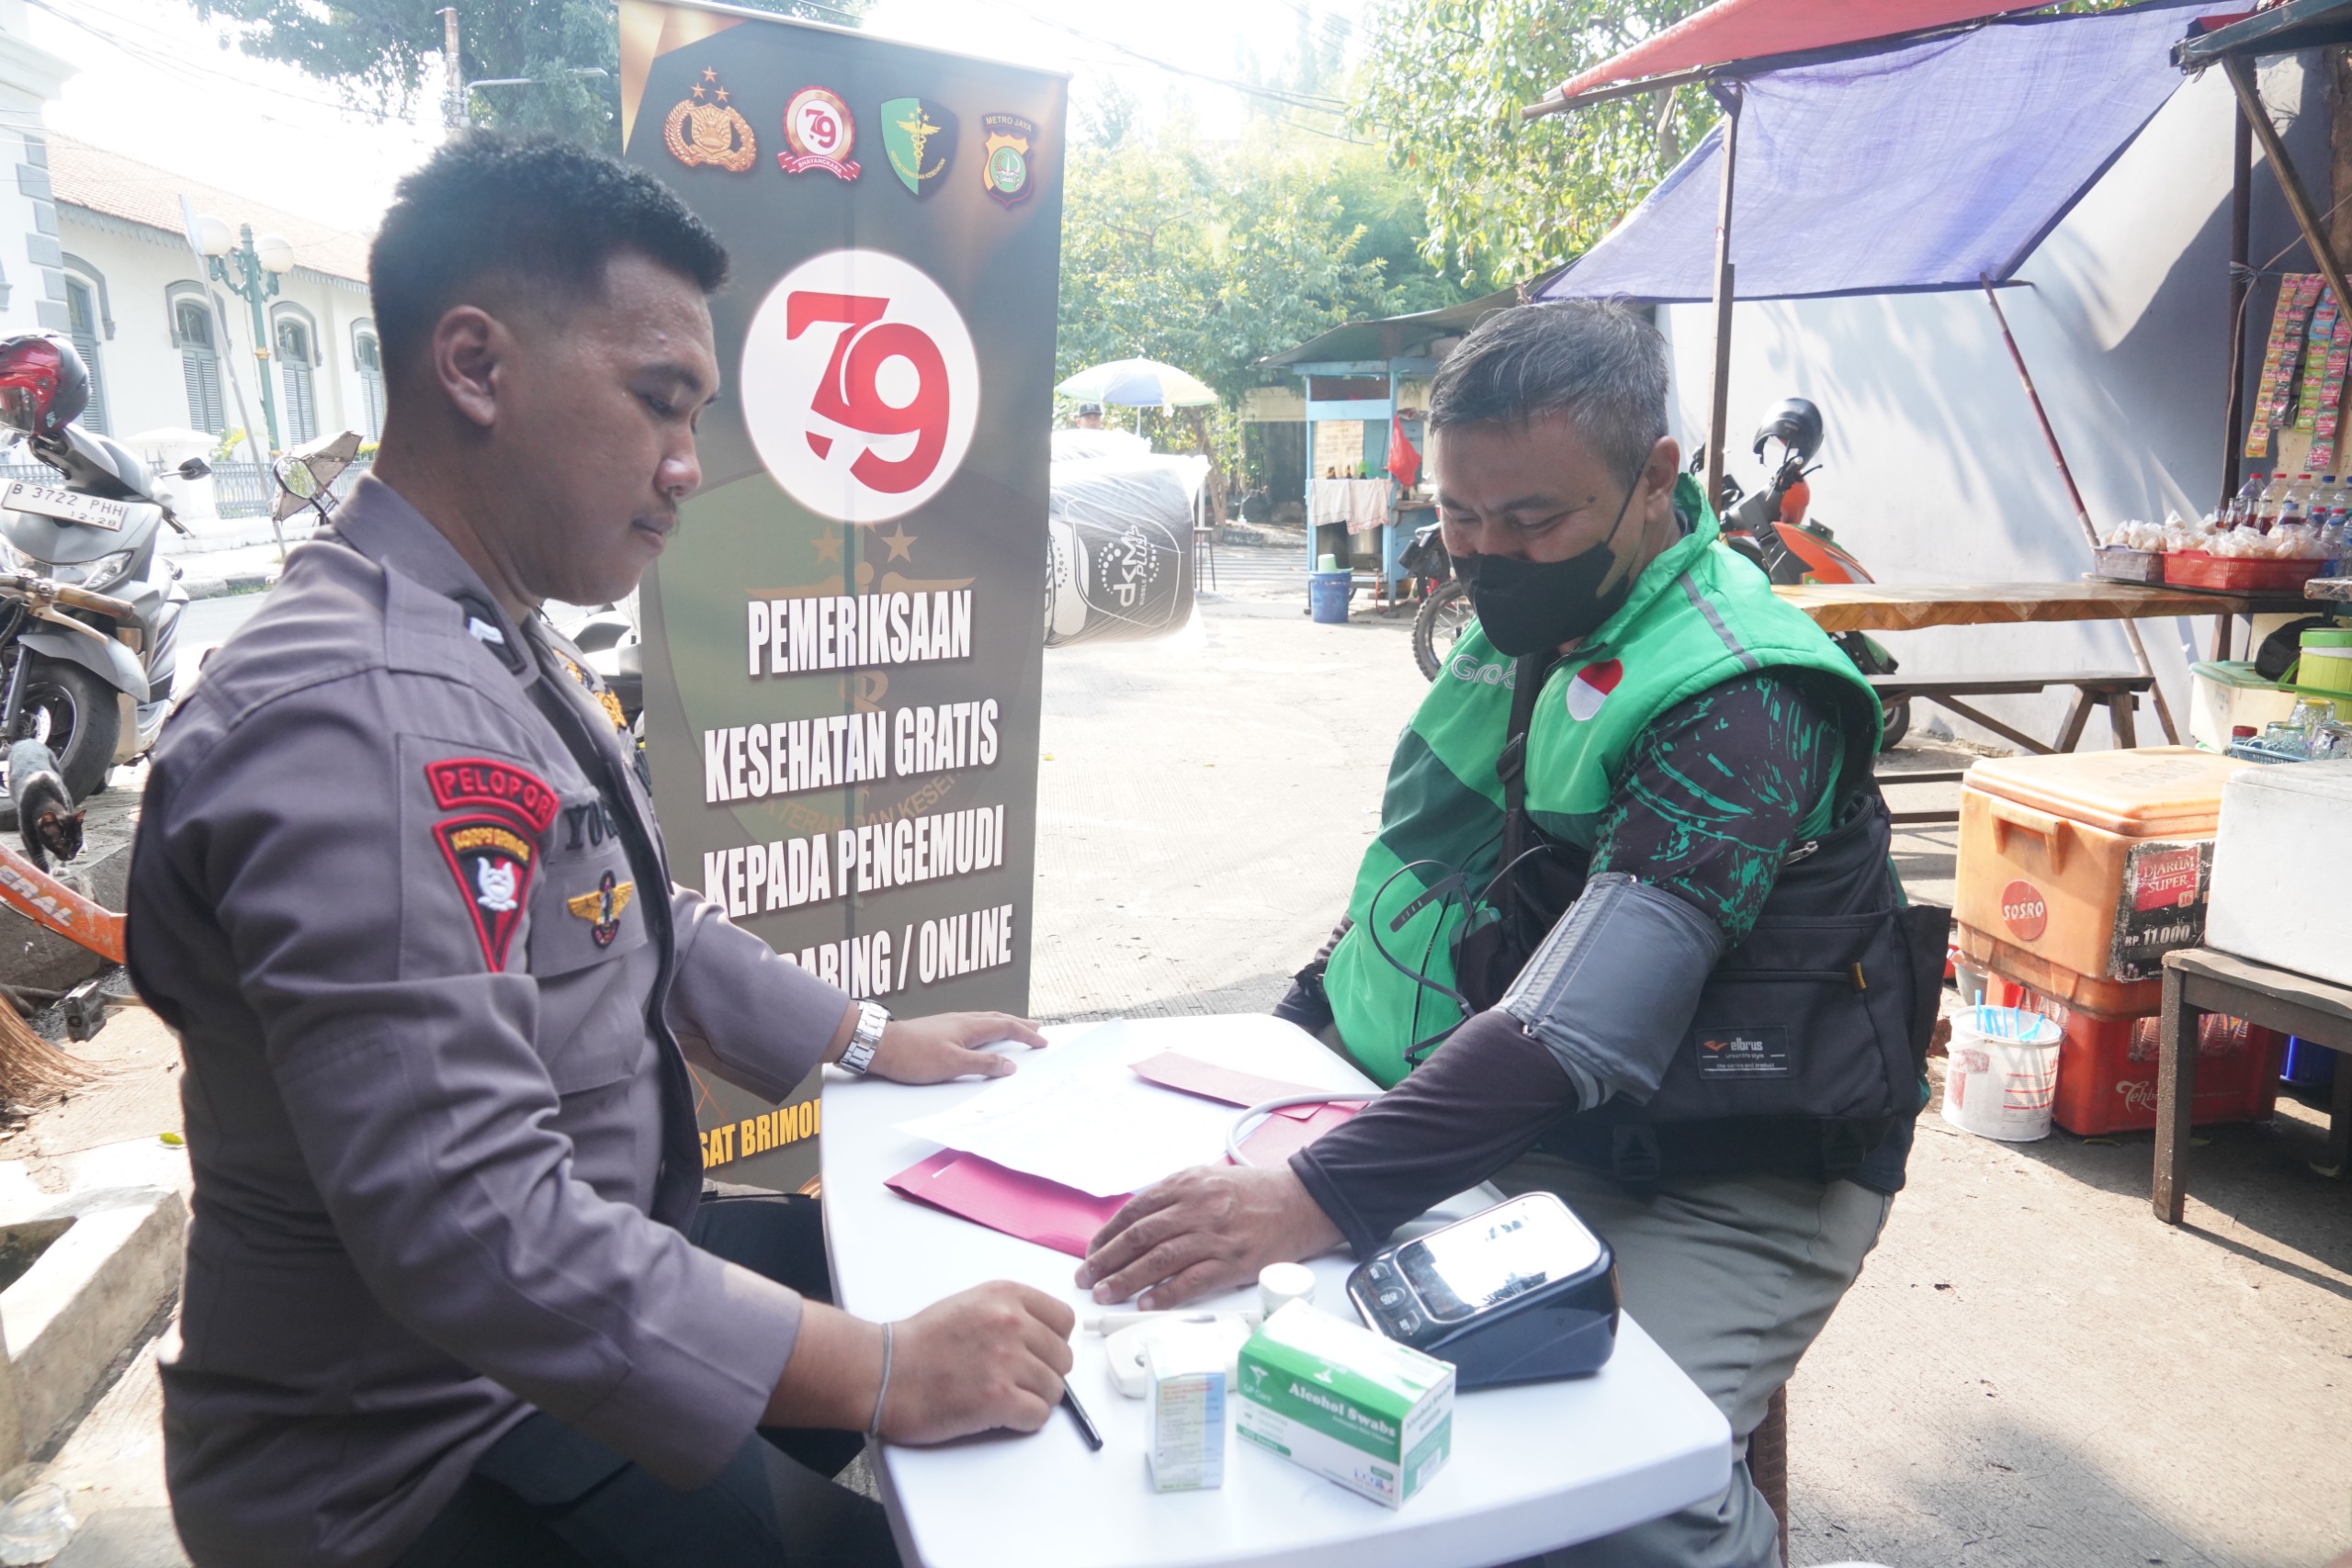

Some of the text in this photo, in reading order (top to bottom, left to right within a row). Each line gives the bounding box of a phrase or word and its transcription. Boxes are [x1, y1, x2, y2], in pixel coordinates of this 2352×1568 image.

[805, 108, 836, 149] 79
[986, 116, 1032, 132] METRO JAYA
[797, 159, 842, 174] BHAYANGKARA
[786, 290, 950, 494] 79
[12, 483, 124, 516] B 3722 PHH
[747, 589, 972, 676] PEMERIKSAAN
[704, 697, 999, 804] KESEHATAN GRATIS
[438, 767, 553, 824] PELOPOR
[704, 804, 1004, 919] KEPADA PENGEMUDI
[2148, 874, 2188, 894] SUPER
[2180, 895, 2192, 906] 16
[2002, 899, 2044, 921] SOSRO
[776, 930, 891, 998] RING
[919, 903, 1013, 984] ONLINE
[1730, 1037, 1763, 1051] elbrus
[1288, 1382, 1345, 1416] Alcohol
[1347, 1406, 1396, 1438] Swabs
